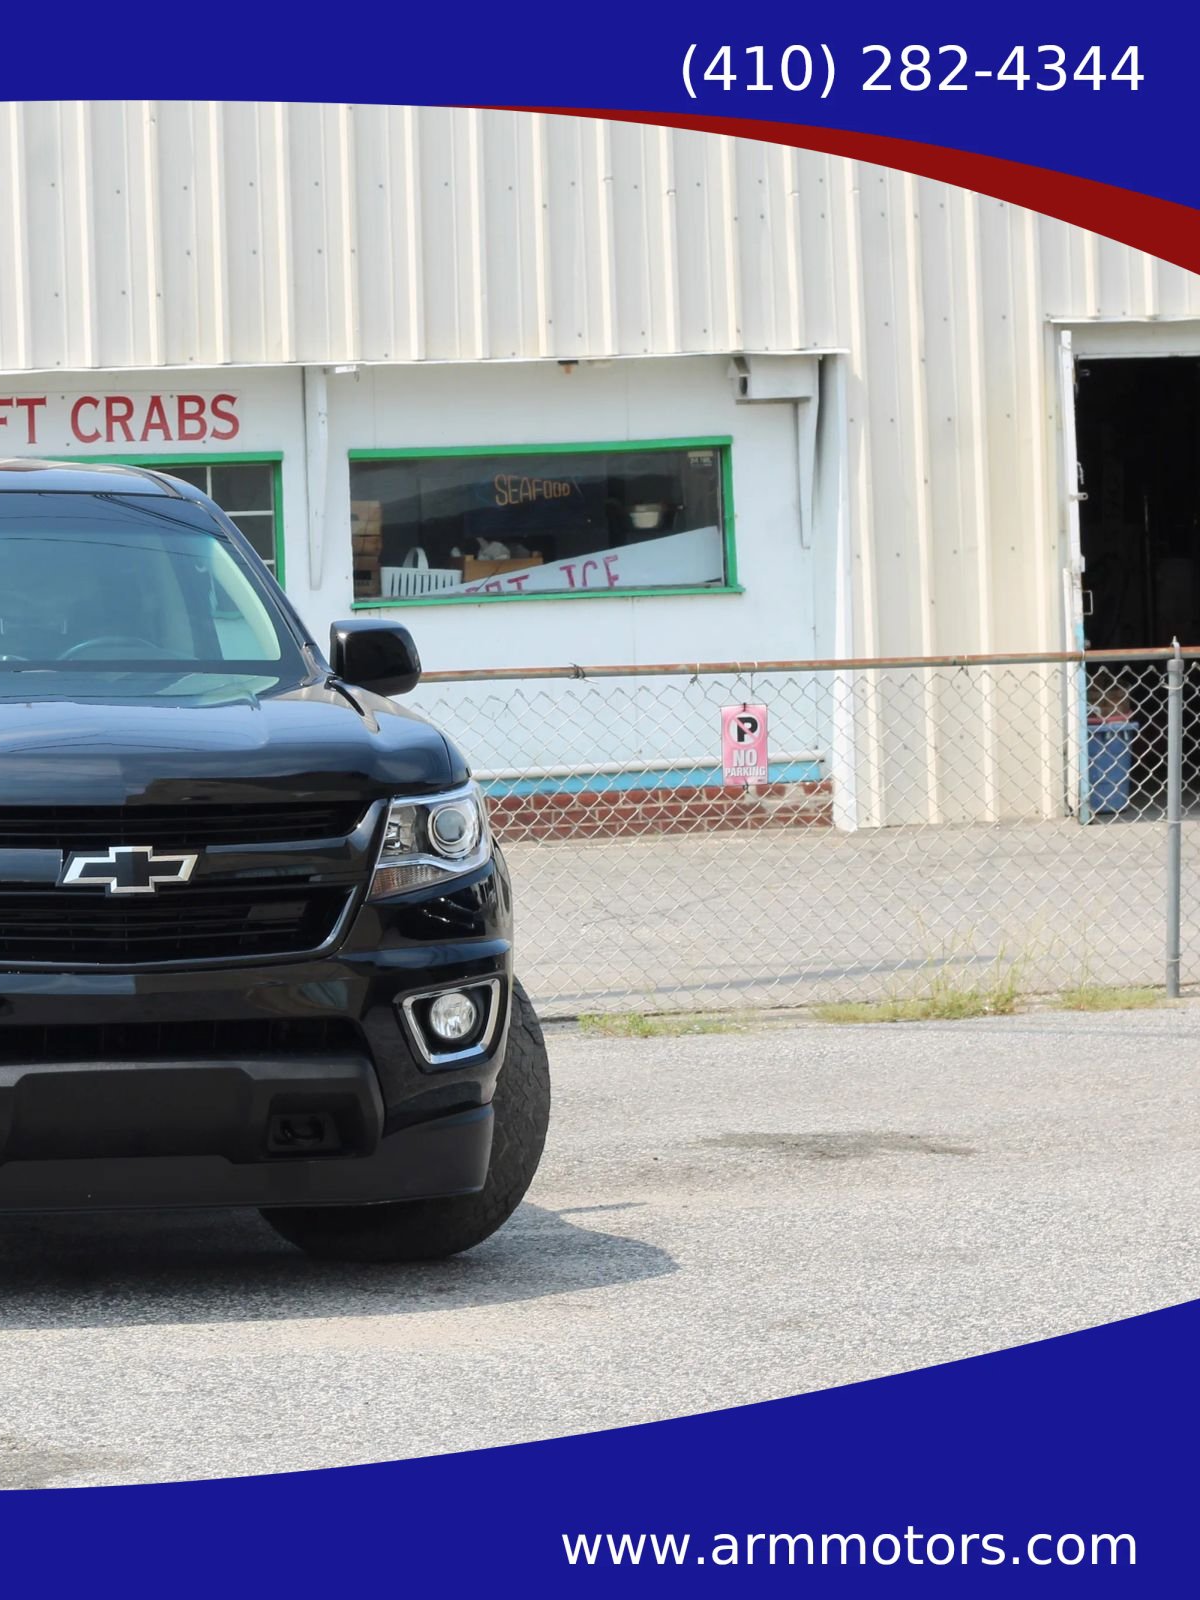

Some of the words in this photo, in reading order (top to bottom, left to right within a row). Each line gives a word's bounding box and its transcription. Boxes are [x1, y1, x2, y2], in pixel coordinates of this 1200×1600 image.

[70, 393, 240, 444] CRABS
[494, 474, 571, 506] SEAFOOD
[732, 749, 757, 767] NO
[725, 767, 766, 777] PARKING
